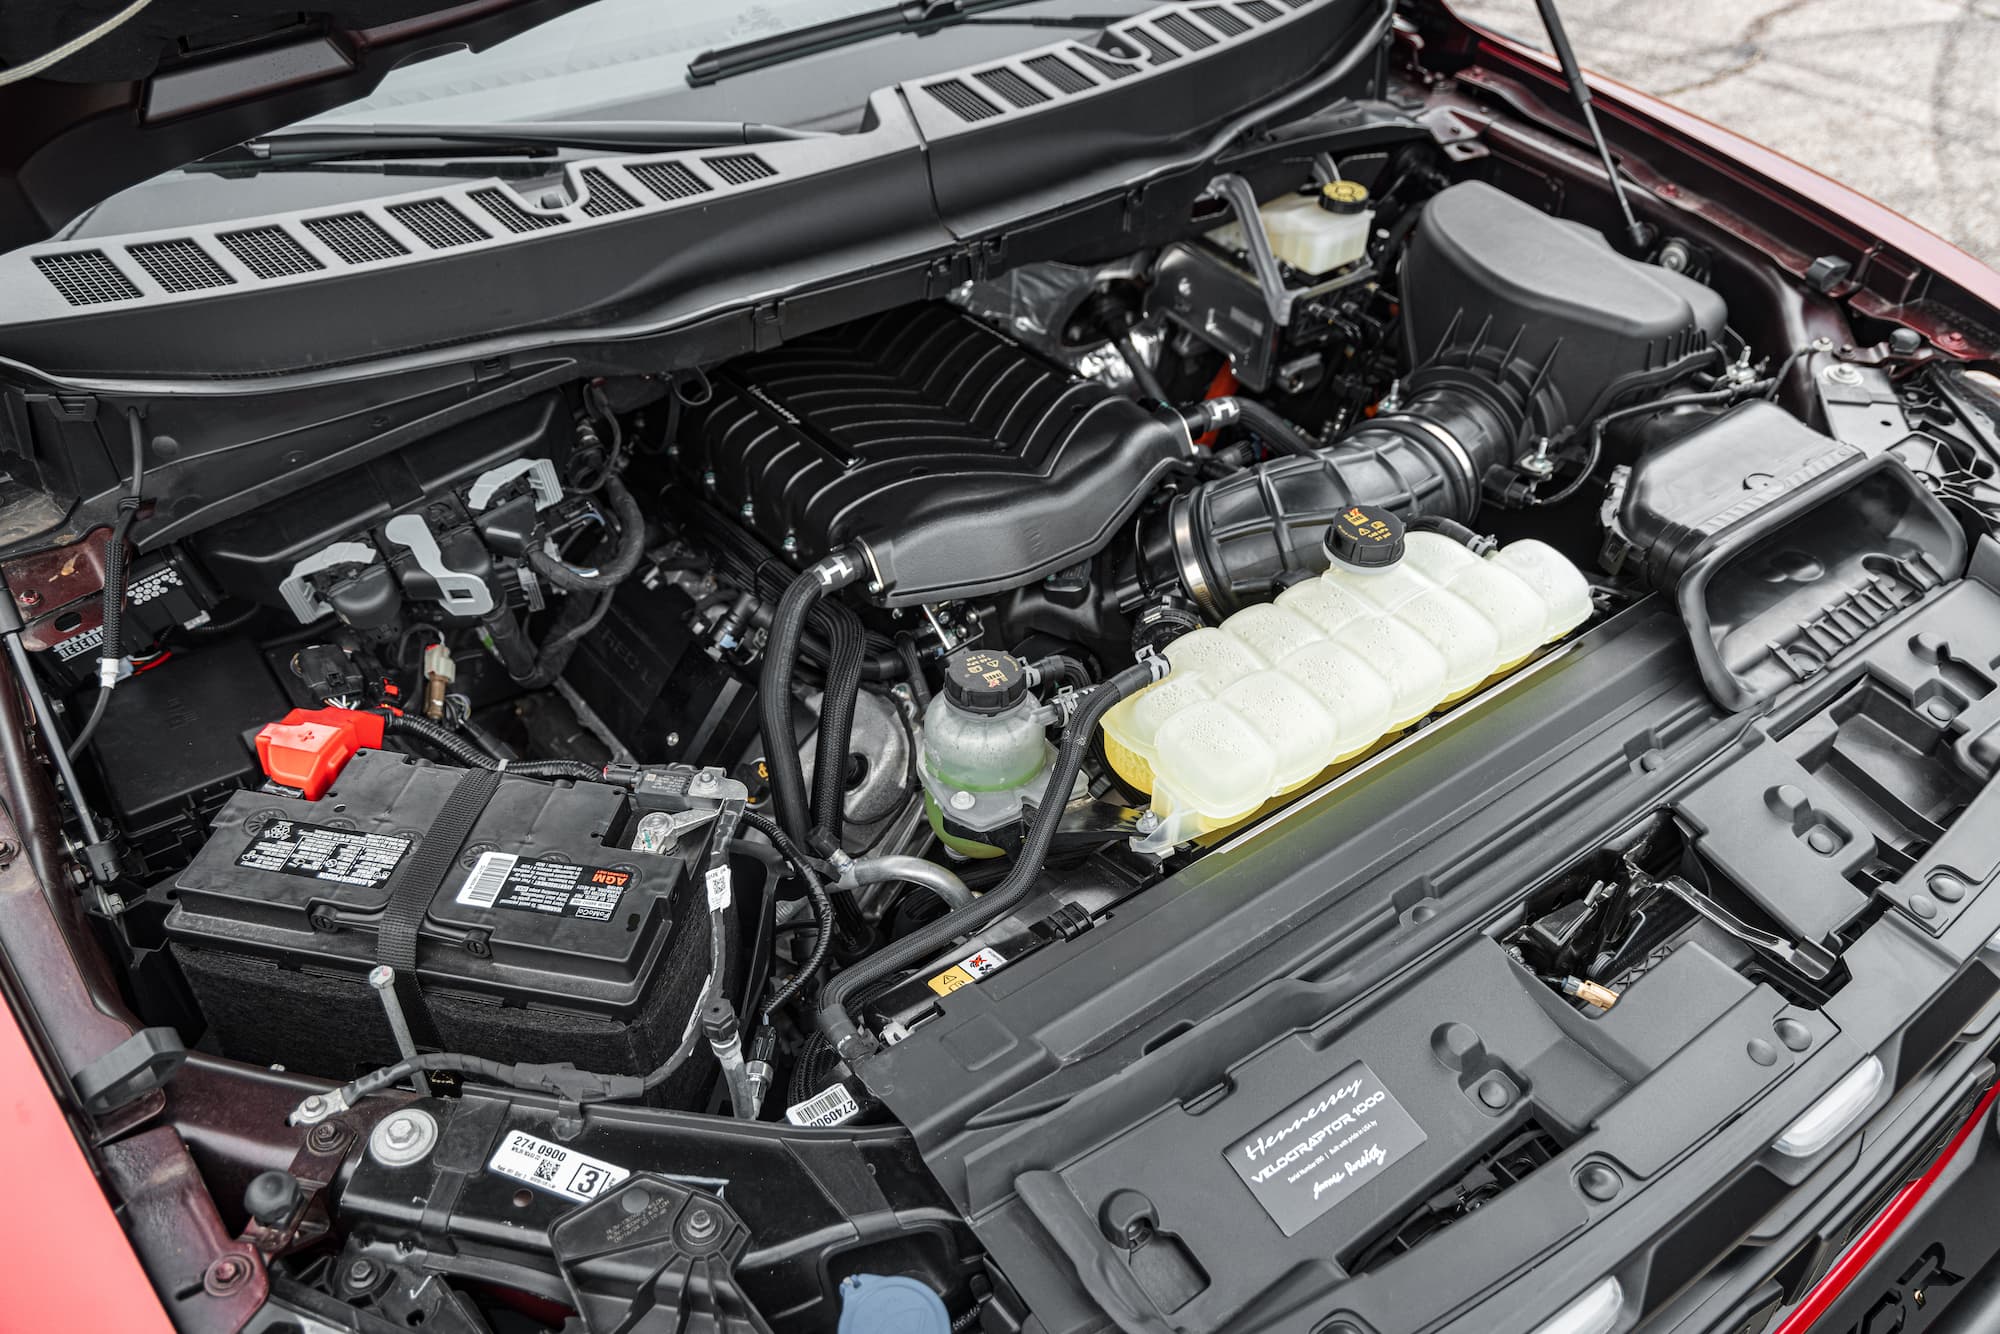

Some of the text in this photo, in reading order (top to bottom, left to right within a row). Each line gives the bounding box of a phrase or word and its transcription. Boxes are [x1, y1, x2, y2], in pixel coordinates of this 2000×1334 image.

[592, 873, 629, 886] AGM
[1245, 1079, 1363, 1161] Hennessey
[1251, 1113, 1356, 1183] VELOCIRAPTOR
[1352, 1090, 1386, 1117] 1000
[512, 1136, 536, 1151] 274
[537, 1144, 568, 1162] 0900
[577, 1170, 600, 1194] 3
[1846, 1241, 1966, 1334] OR
